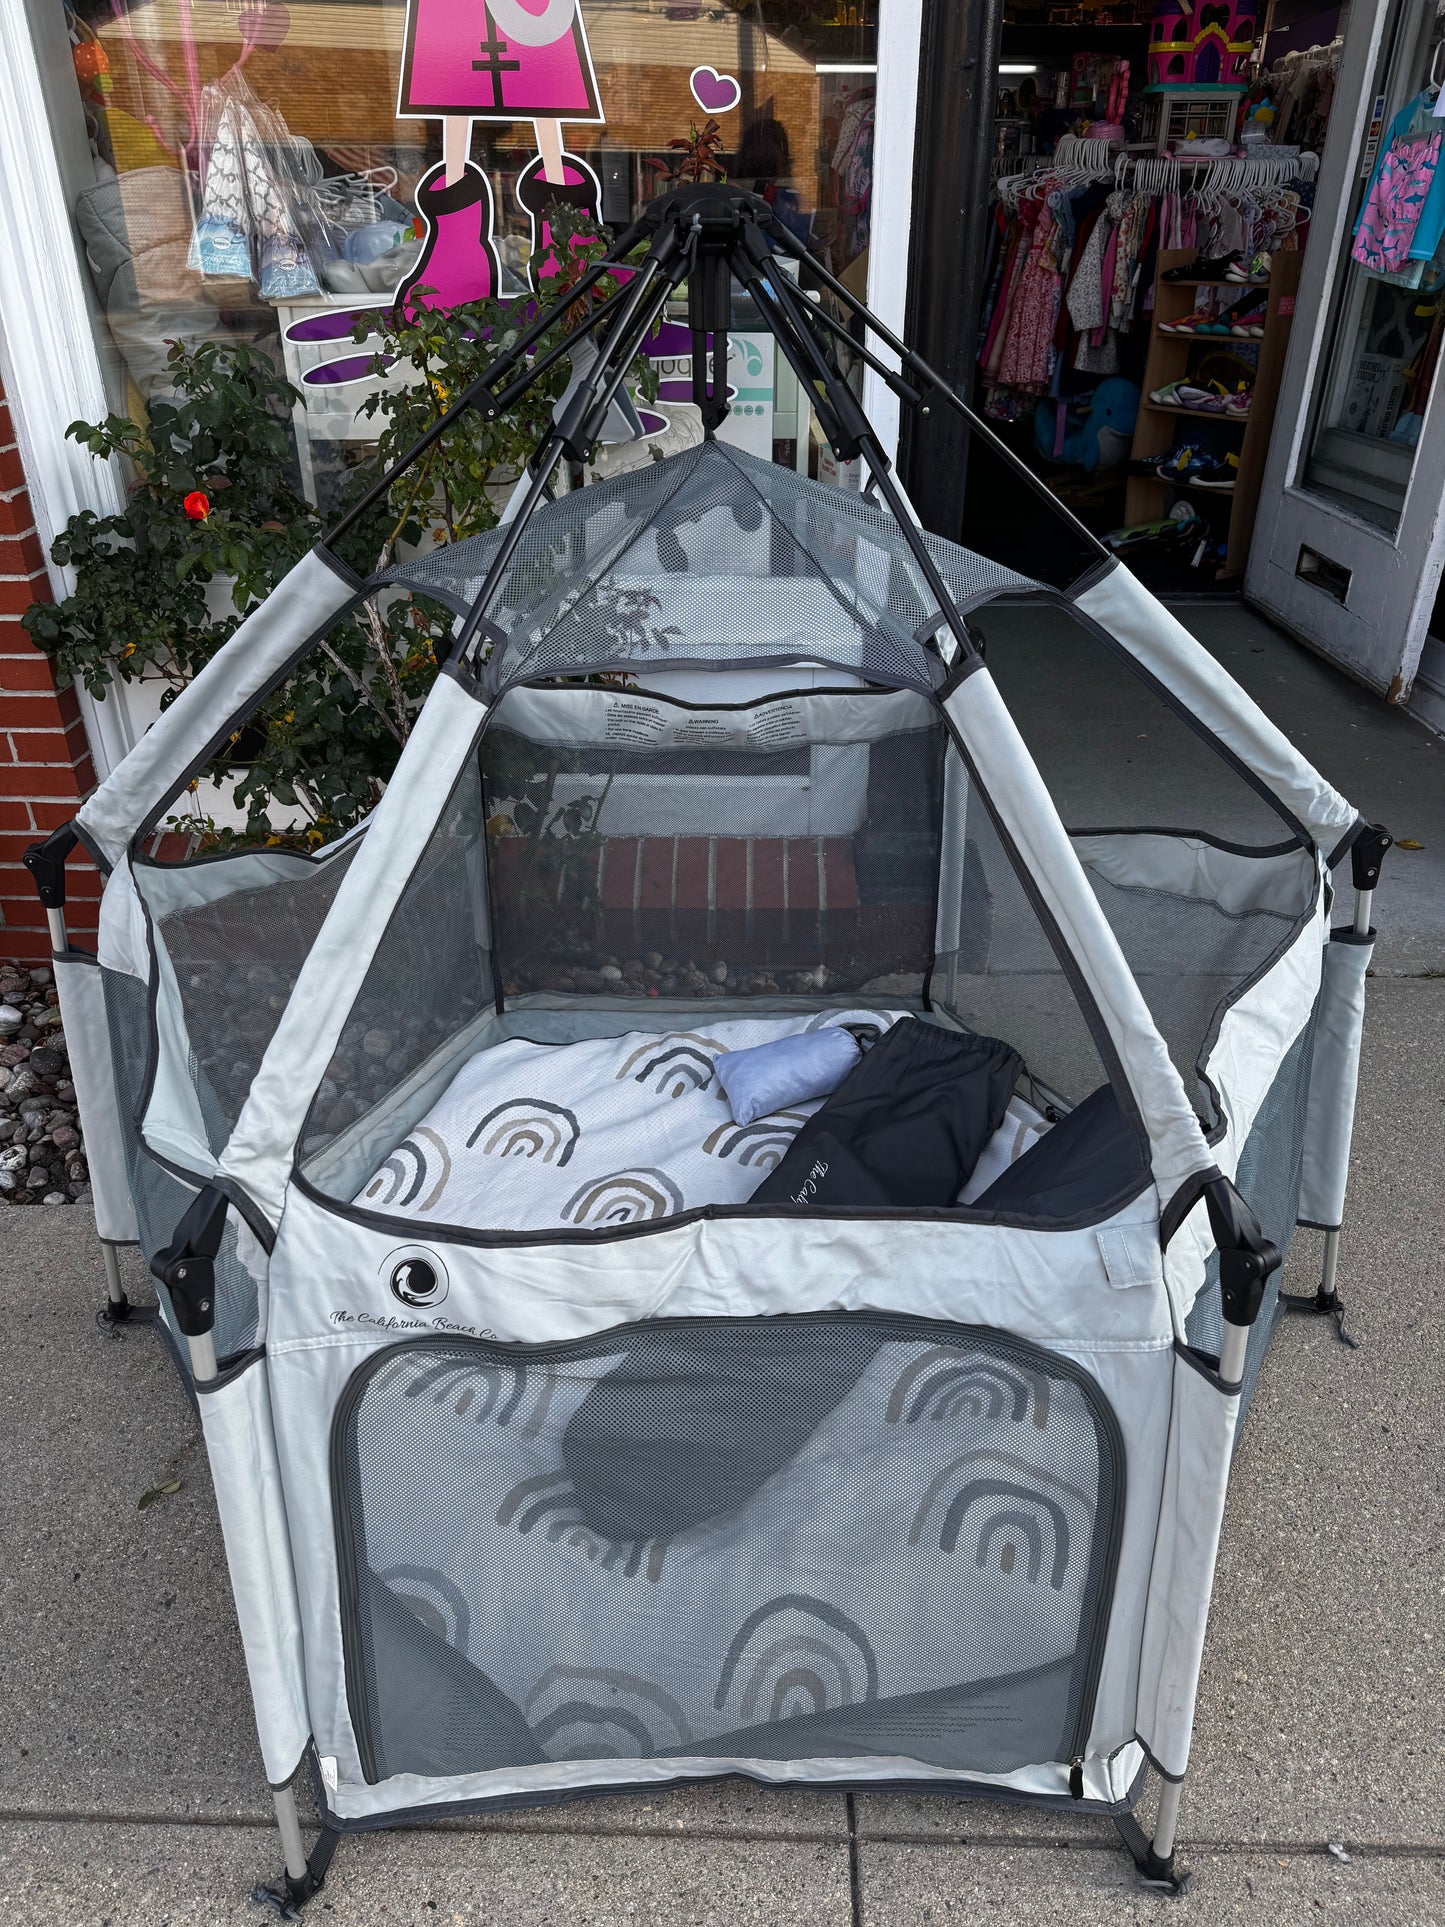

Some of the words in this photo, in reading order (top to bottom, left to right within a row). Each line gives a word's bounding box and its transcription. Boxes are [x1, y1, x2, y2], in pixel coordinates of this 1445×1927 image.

[759, 705, 793, 717] ADVERTENCIA
[810, 1160, 829, 1179] The
[330, 1310, 355, 1325] The
[357, 1313, 429, 1330] California
[432, 1317, 477, 1335] Beach
